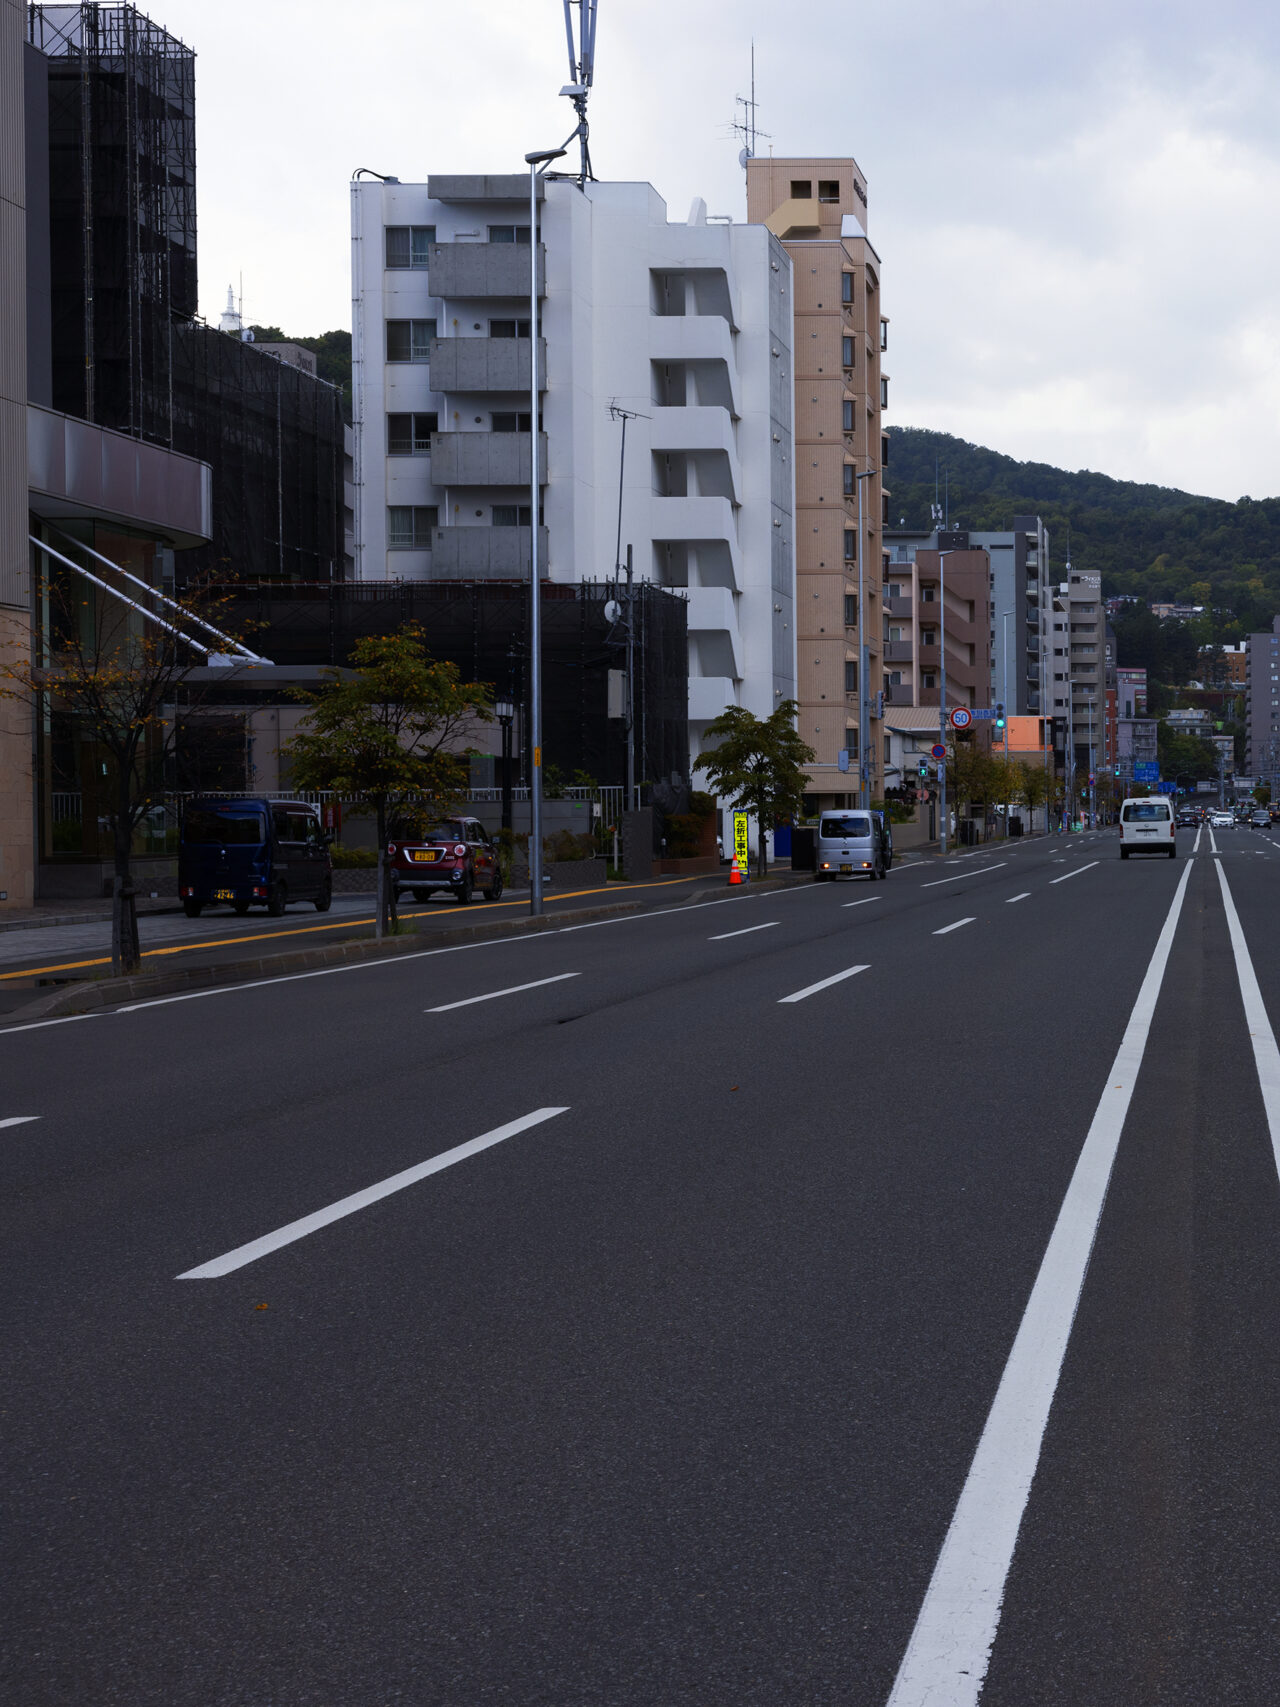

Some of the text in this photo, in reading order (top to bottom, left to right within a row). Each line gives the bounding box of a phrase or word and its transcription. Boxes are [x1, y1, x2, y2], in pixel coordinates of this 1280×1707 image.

[955, 713, 968, 724] 50
[736, 820, 746, 857] 左折工事中
